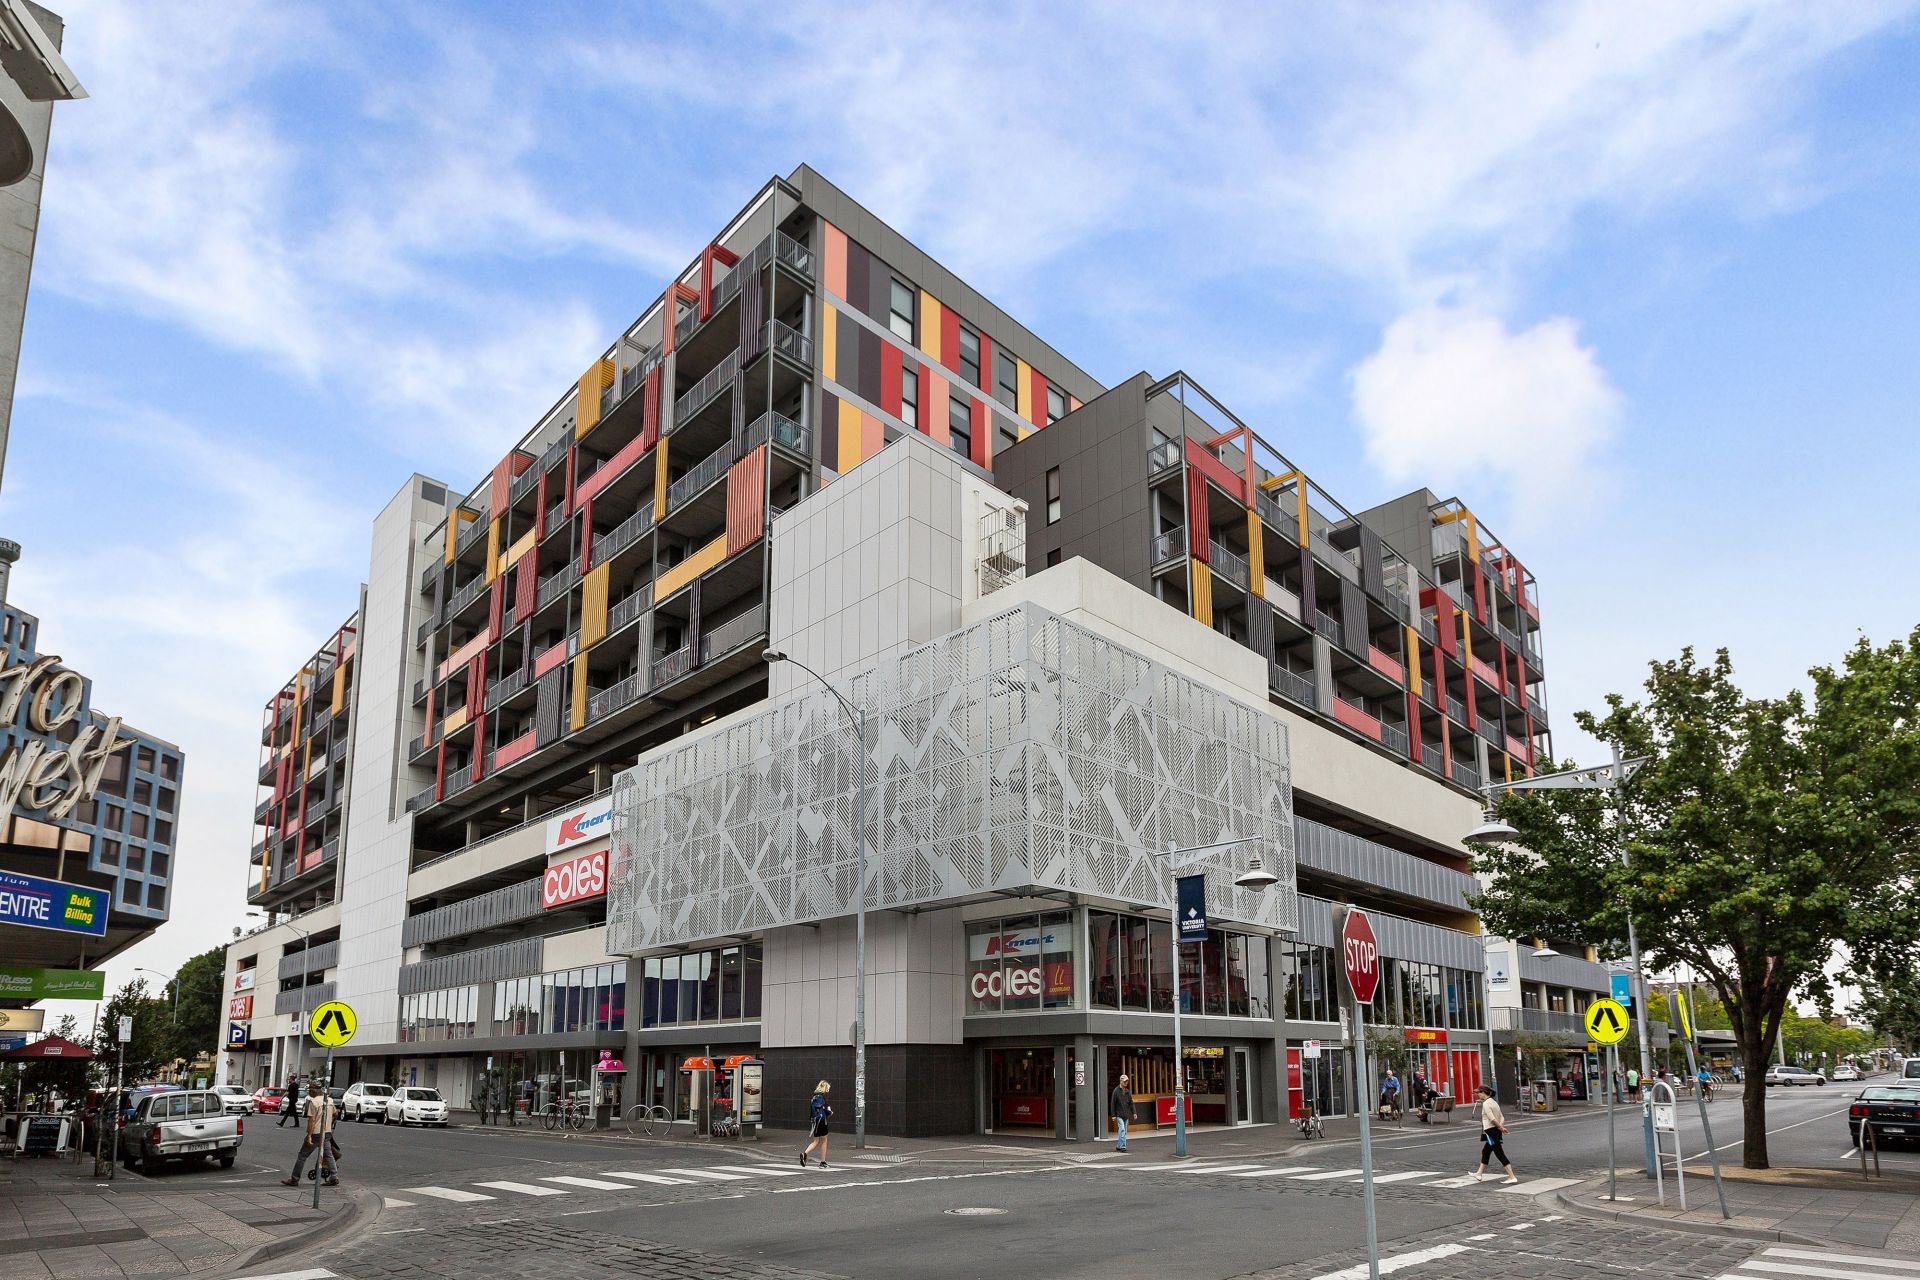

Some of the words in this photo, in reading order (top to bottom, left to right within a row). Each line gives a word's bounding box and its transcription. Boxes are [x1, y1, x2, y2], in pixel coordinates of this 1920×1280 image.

[557, 809, 612, 846] Kmart
[545, 855, 604, 903] coles
[0, 892, 50, 920] ENTRE
[70, 894, 91, 907] Bulk
[65, 908, 93, 924] Billing
[985, 934, 1054, 956] Kmart
[1346, 938, 1376, 974] STOP
[971, 968, 1045, 998] coles
[232, 1030, 243, 1042] P
